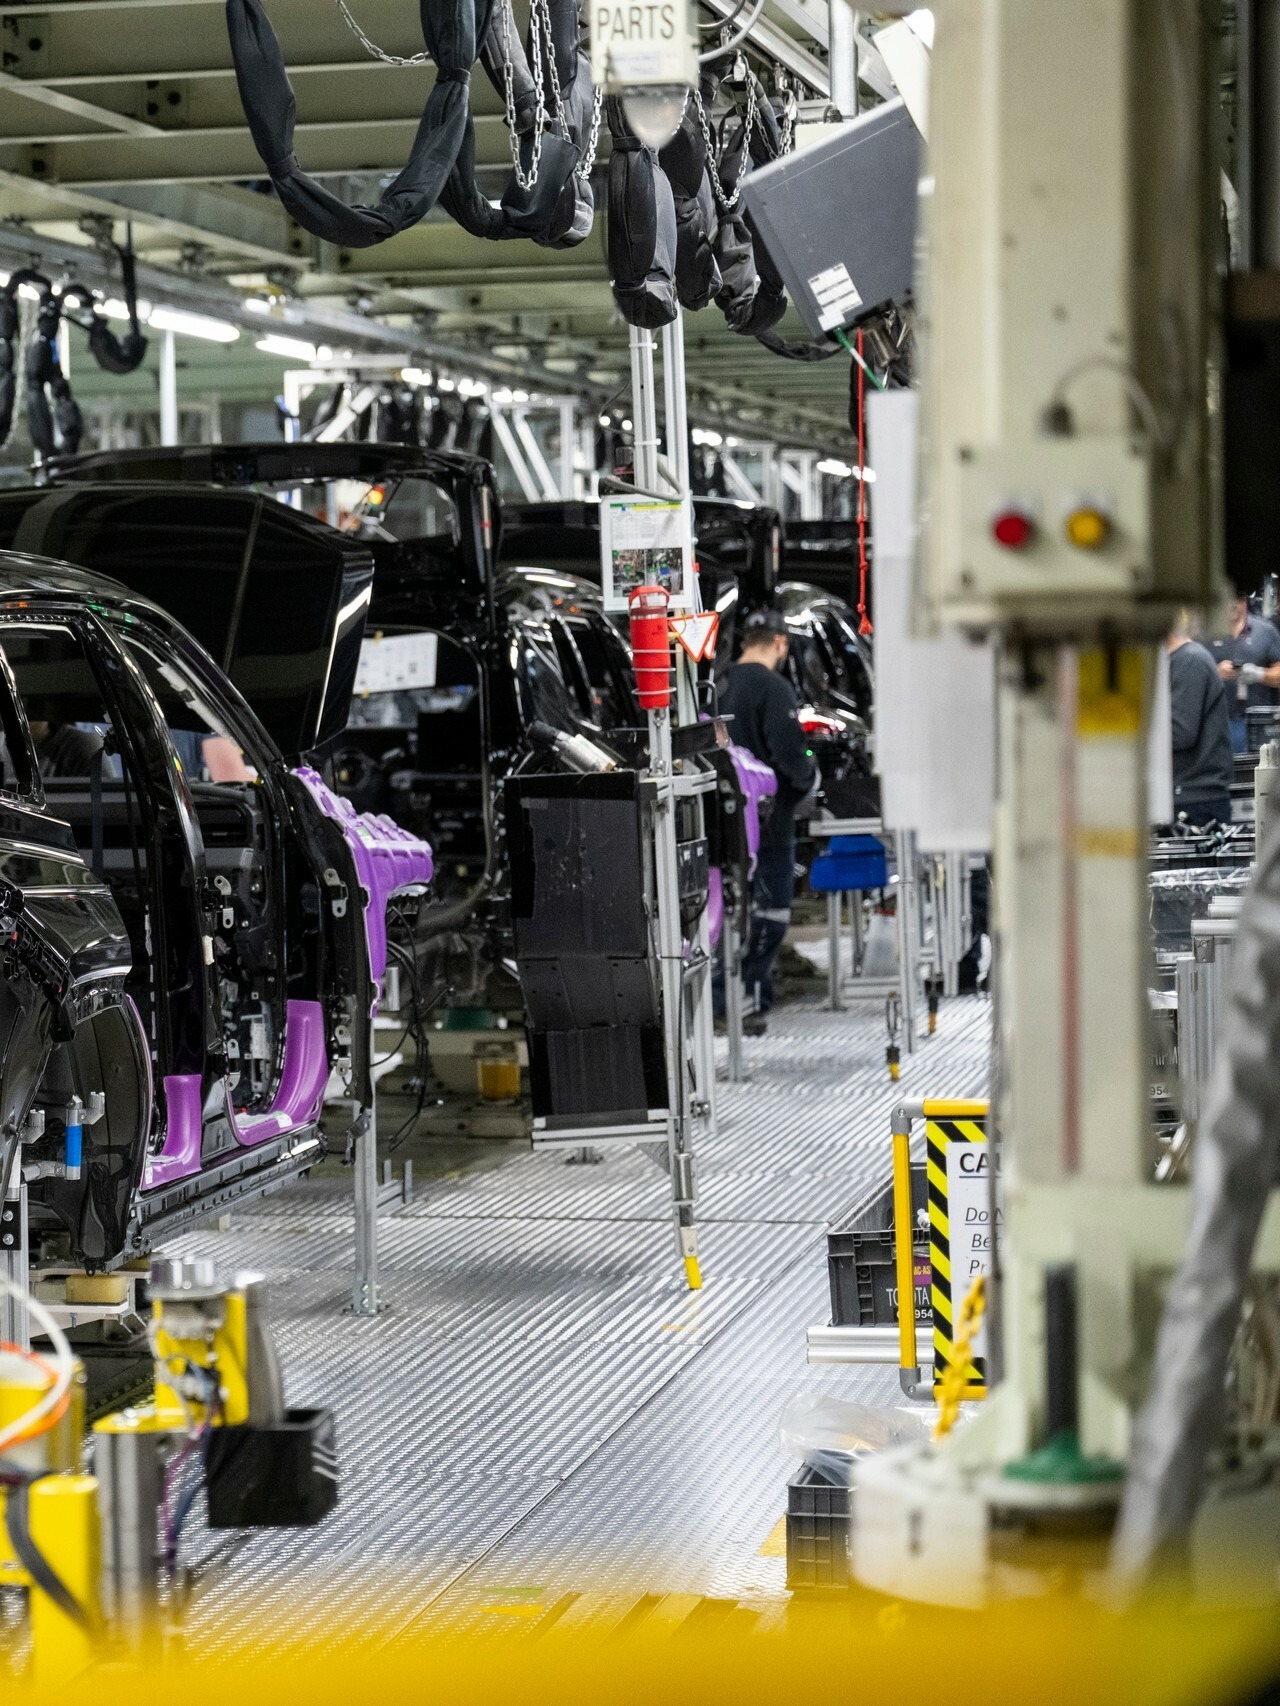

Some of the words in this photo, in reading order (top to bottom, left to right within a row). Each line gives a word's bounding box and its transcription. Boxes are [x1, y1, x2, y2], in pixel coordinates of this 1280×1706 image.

[596, 3, 676, 41] PARTS
[965, 1207, 989, 1223] Do
[885, 1286, 930, 1307] TOTA
